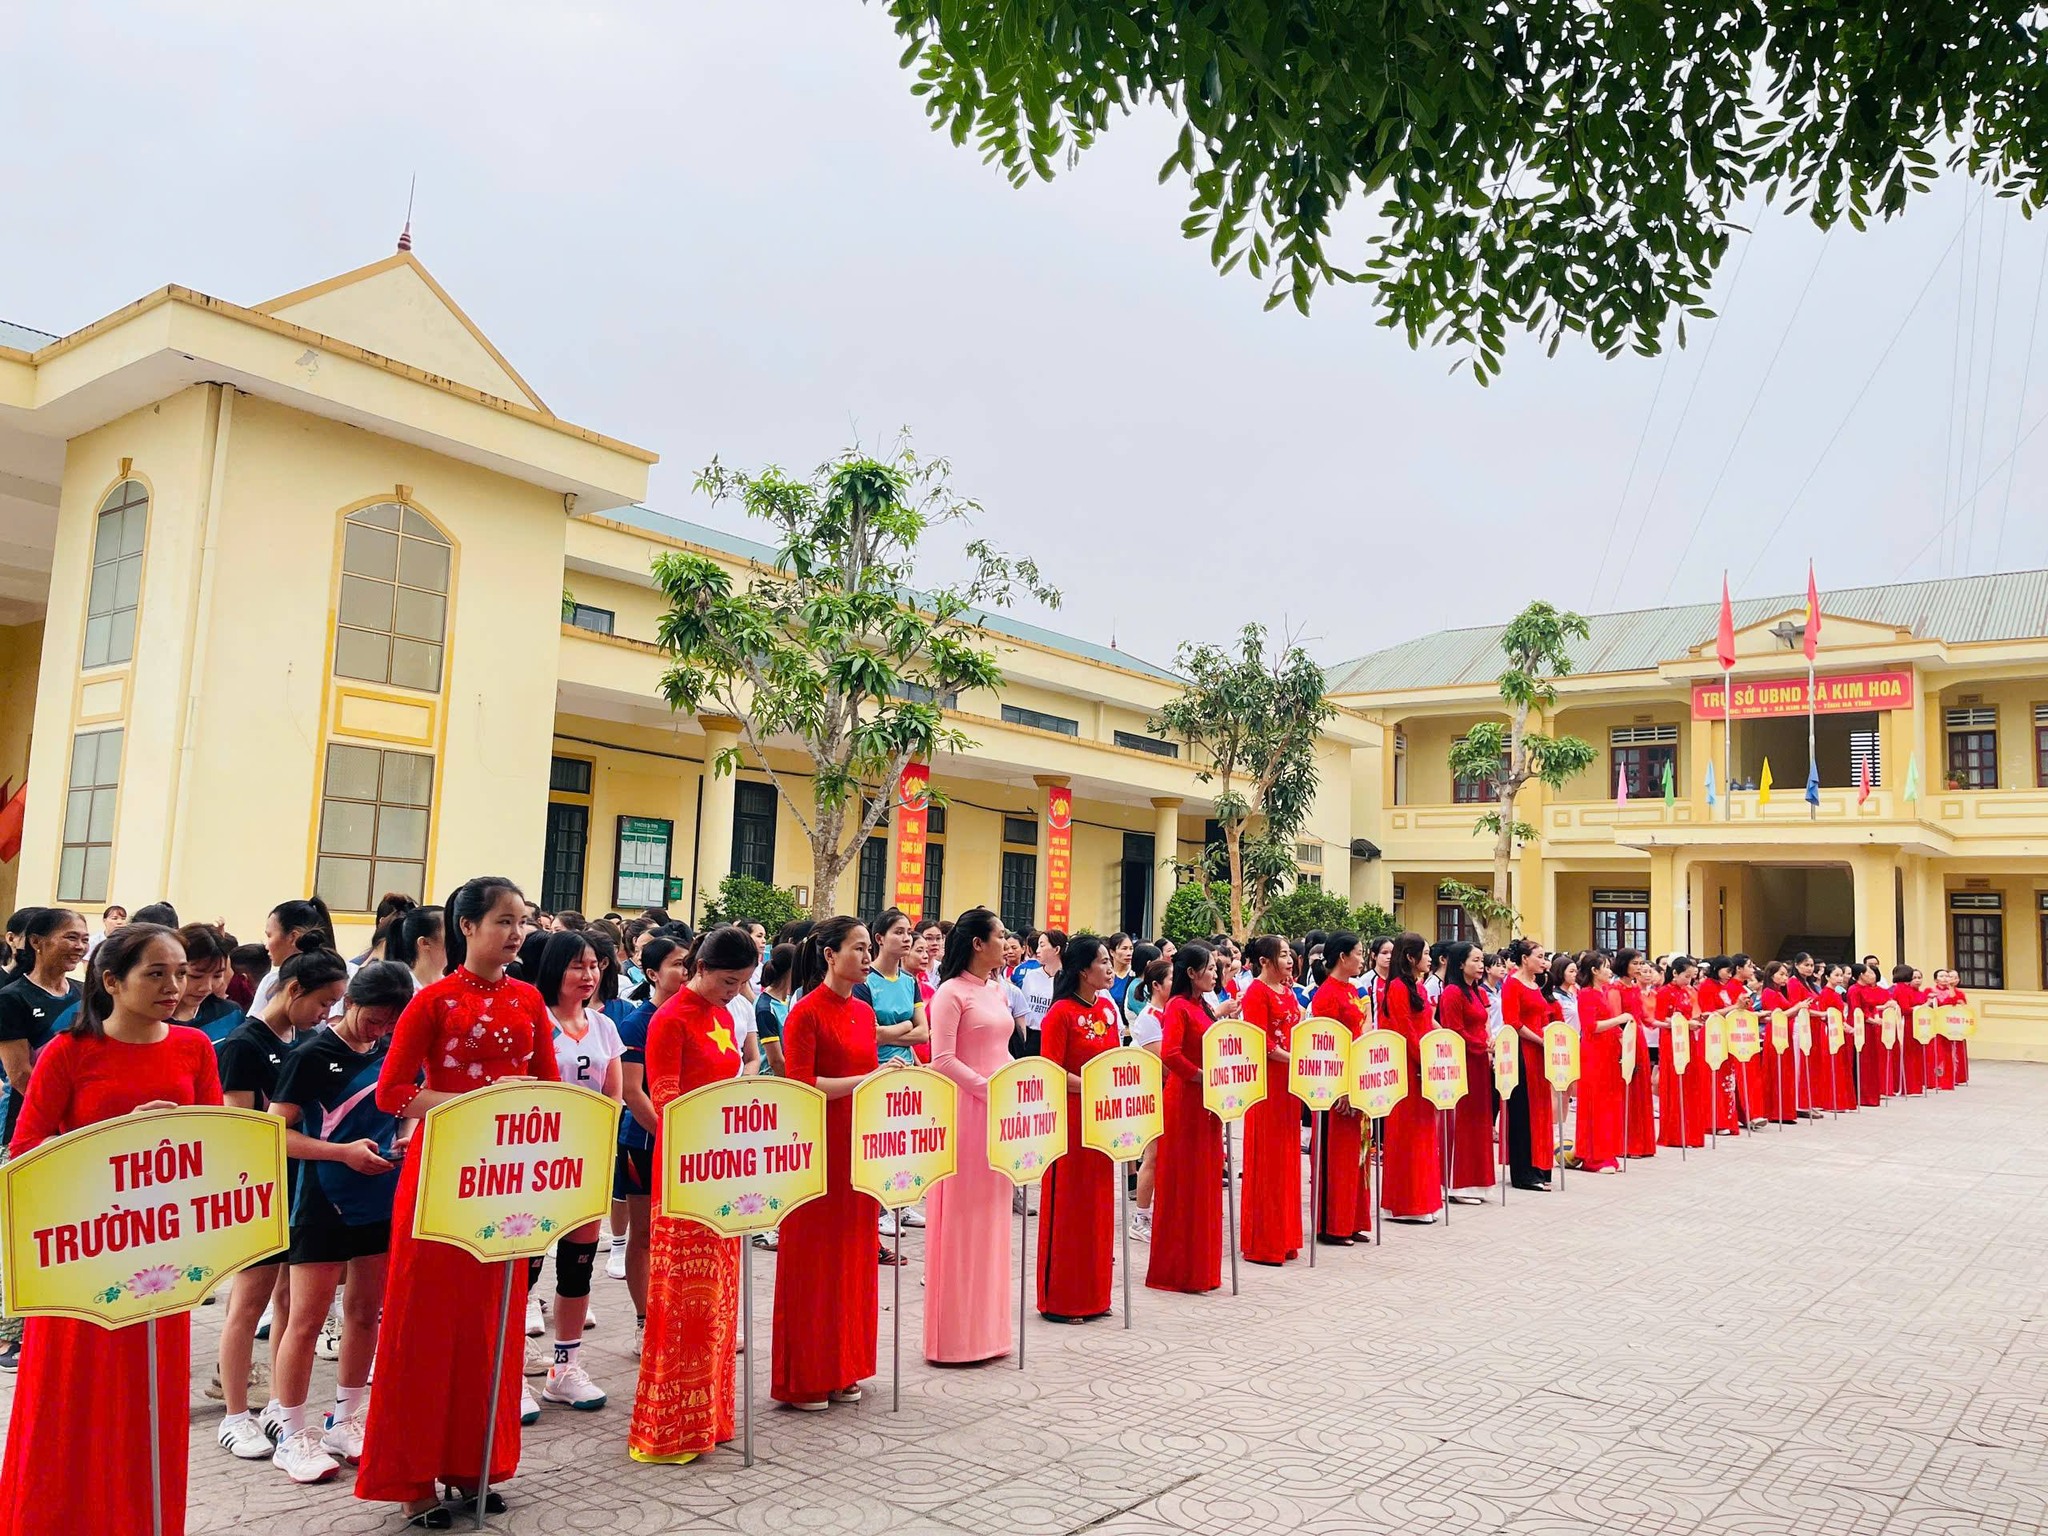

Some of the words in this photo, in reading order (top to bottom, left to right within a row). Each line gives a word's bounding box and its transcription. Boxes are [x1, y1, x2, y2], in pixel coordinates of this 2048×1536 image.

[1759, 687, 1802, 704] UBND
[1832, 682, 1864, 700] KIM
[1869, 680, 1902, 697] HOA
[1218, 1034, 1243, 1057] THÔN
[1312, 1031, 1335, 1052] THÔN
[1369, 1045, 1390, 1064] THÔN
[1436, 1040, 1453, 1058] THÔN
[577, 1056, 590, 1080] 2
[1112, 1064, 1141, 1087] THÔN
[1209, 1066, 1231, 1088] LONG
[1231, 1057, 1259, 1084] THỦY
[1298, 1056, 1322, 1077] BÌNH
[1323, 1053, 1345, 1078] THỦY
[1359, 1068, 1382, 1091] HÙNG
[1383, 1068, 1400, 1086] SƠN
[885, 1085, 923, 1118] THÔN
[1016, 1077, 1044, 1103] THÔN
[721, 1098, 778, 1135] THÔN
[999, 1113, 1031, 1141] XUÂN
[1032, 1103, 1058, 1136] THỦY
[1095, 1095, 1124, 1122] HÀM
[1125, 1093, 1156, 1119] GIANG
[494, 1105, 563, 1147] THÔN
[862, 1129, 907, 1161] TRUNG
[911, 1116, 948, 1154] THỦY
[108, 1138, 205, 1194] THÔN
[679, 1146, 757, 1185] HƯƠNG
[763, 1131, 813, 1174] THỦY
[458, 1158, 524, 1200] BÌNH
[531, 1155, 585, 1193] SƠN
[32, 1202, 182, 1269] TRƯỜNG
[192, 1170, 276, 1233] THỦY
